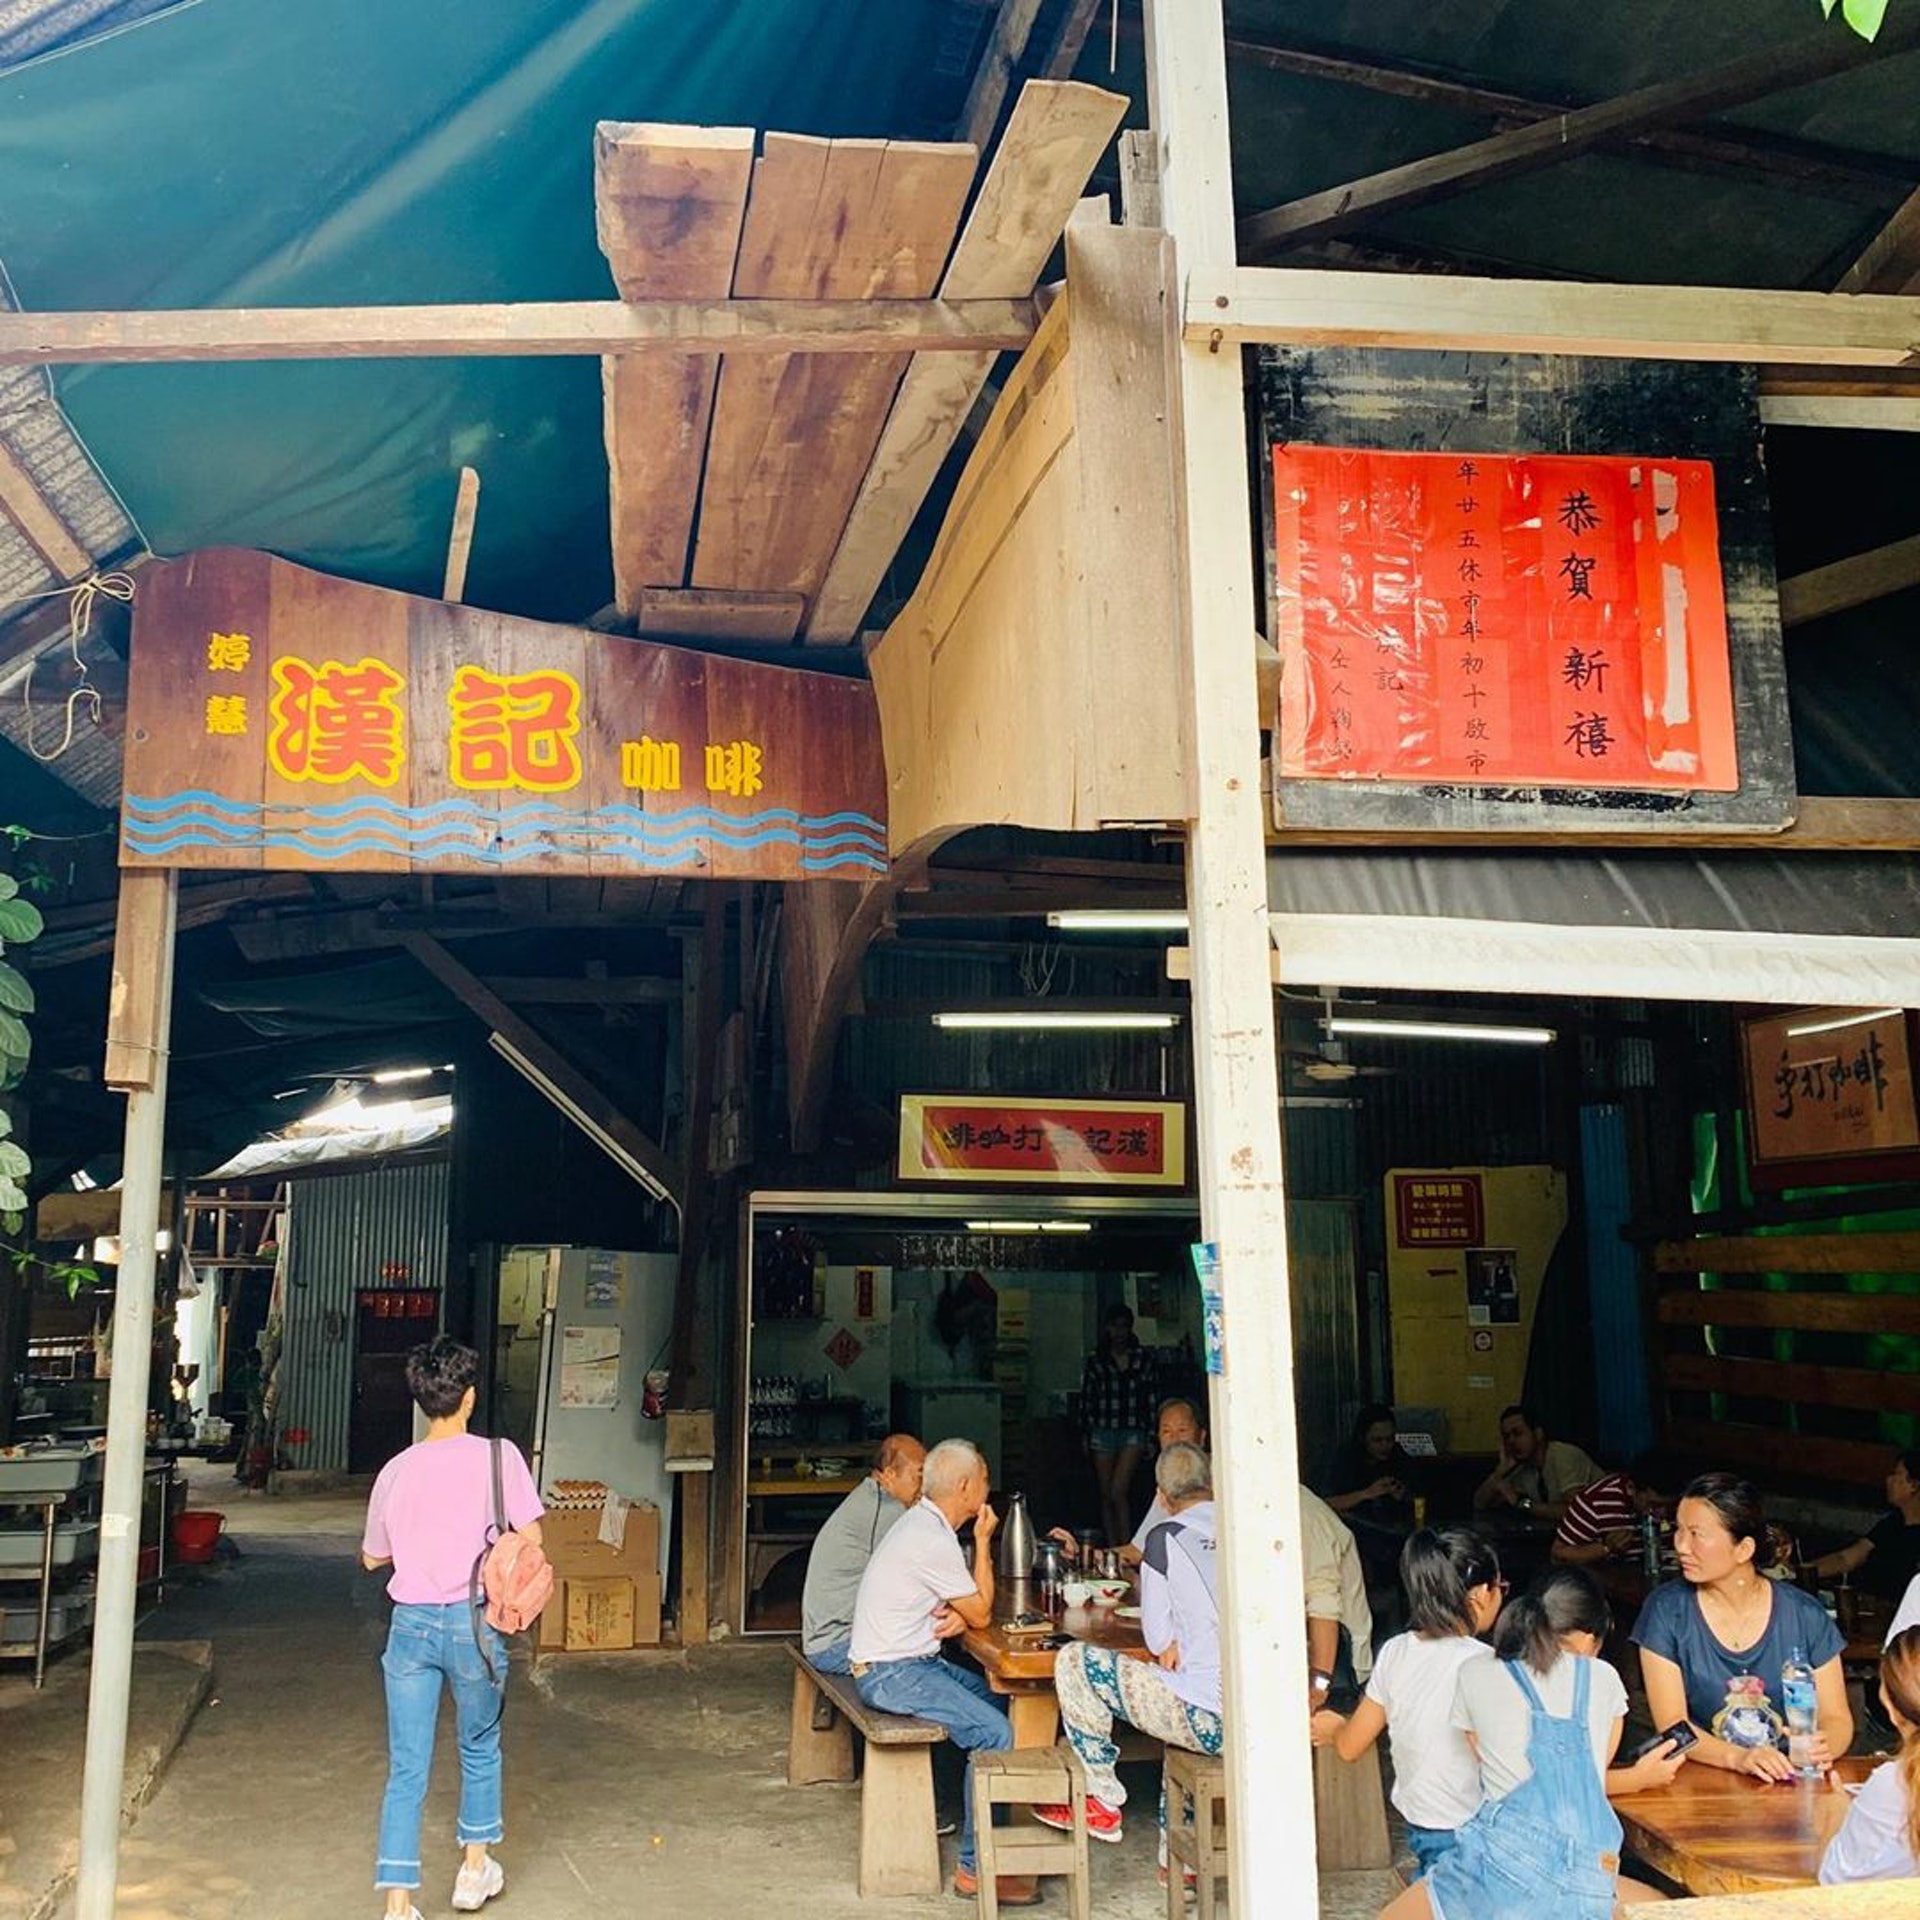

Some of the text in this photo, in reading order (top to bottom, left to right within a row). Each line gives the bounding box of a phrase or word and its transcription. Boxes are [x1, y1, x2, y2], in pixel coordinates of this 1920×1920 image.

[268, 655, 763, 797] 漢記 咖啡
[1557, 490, 1615, 759] 恭賀新禧
